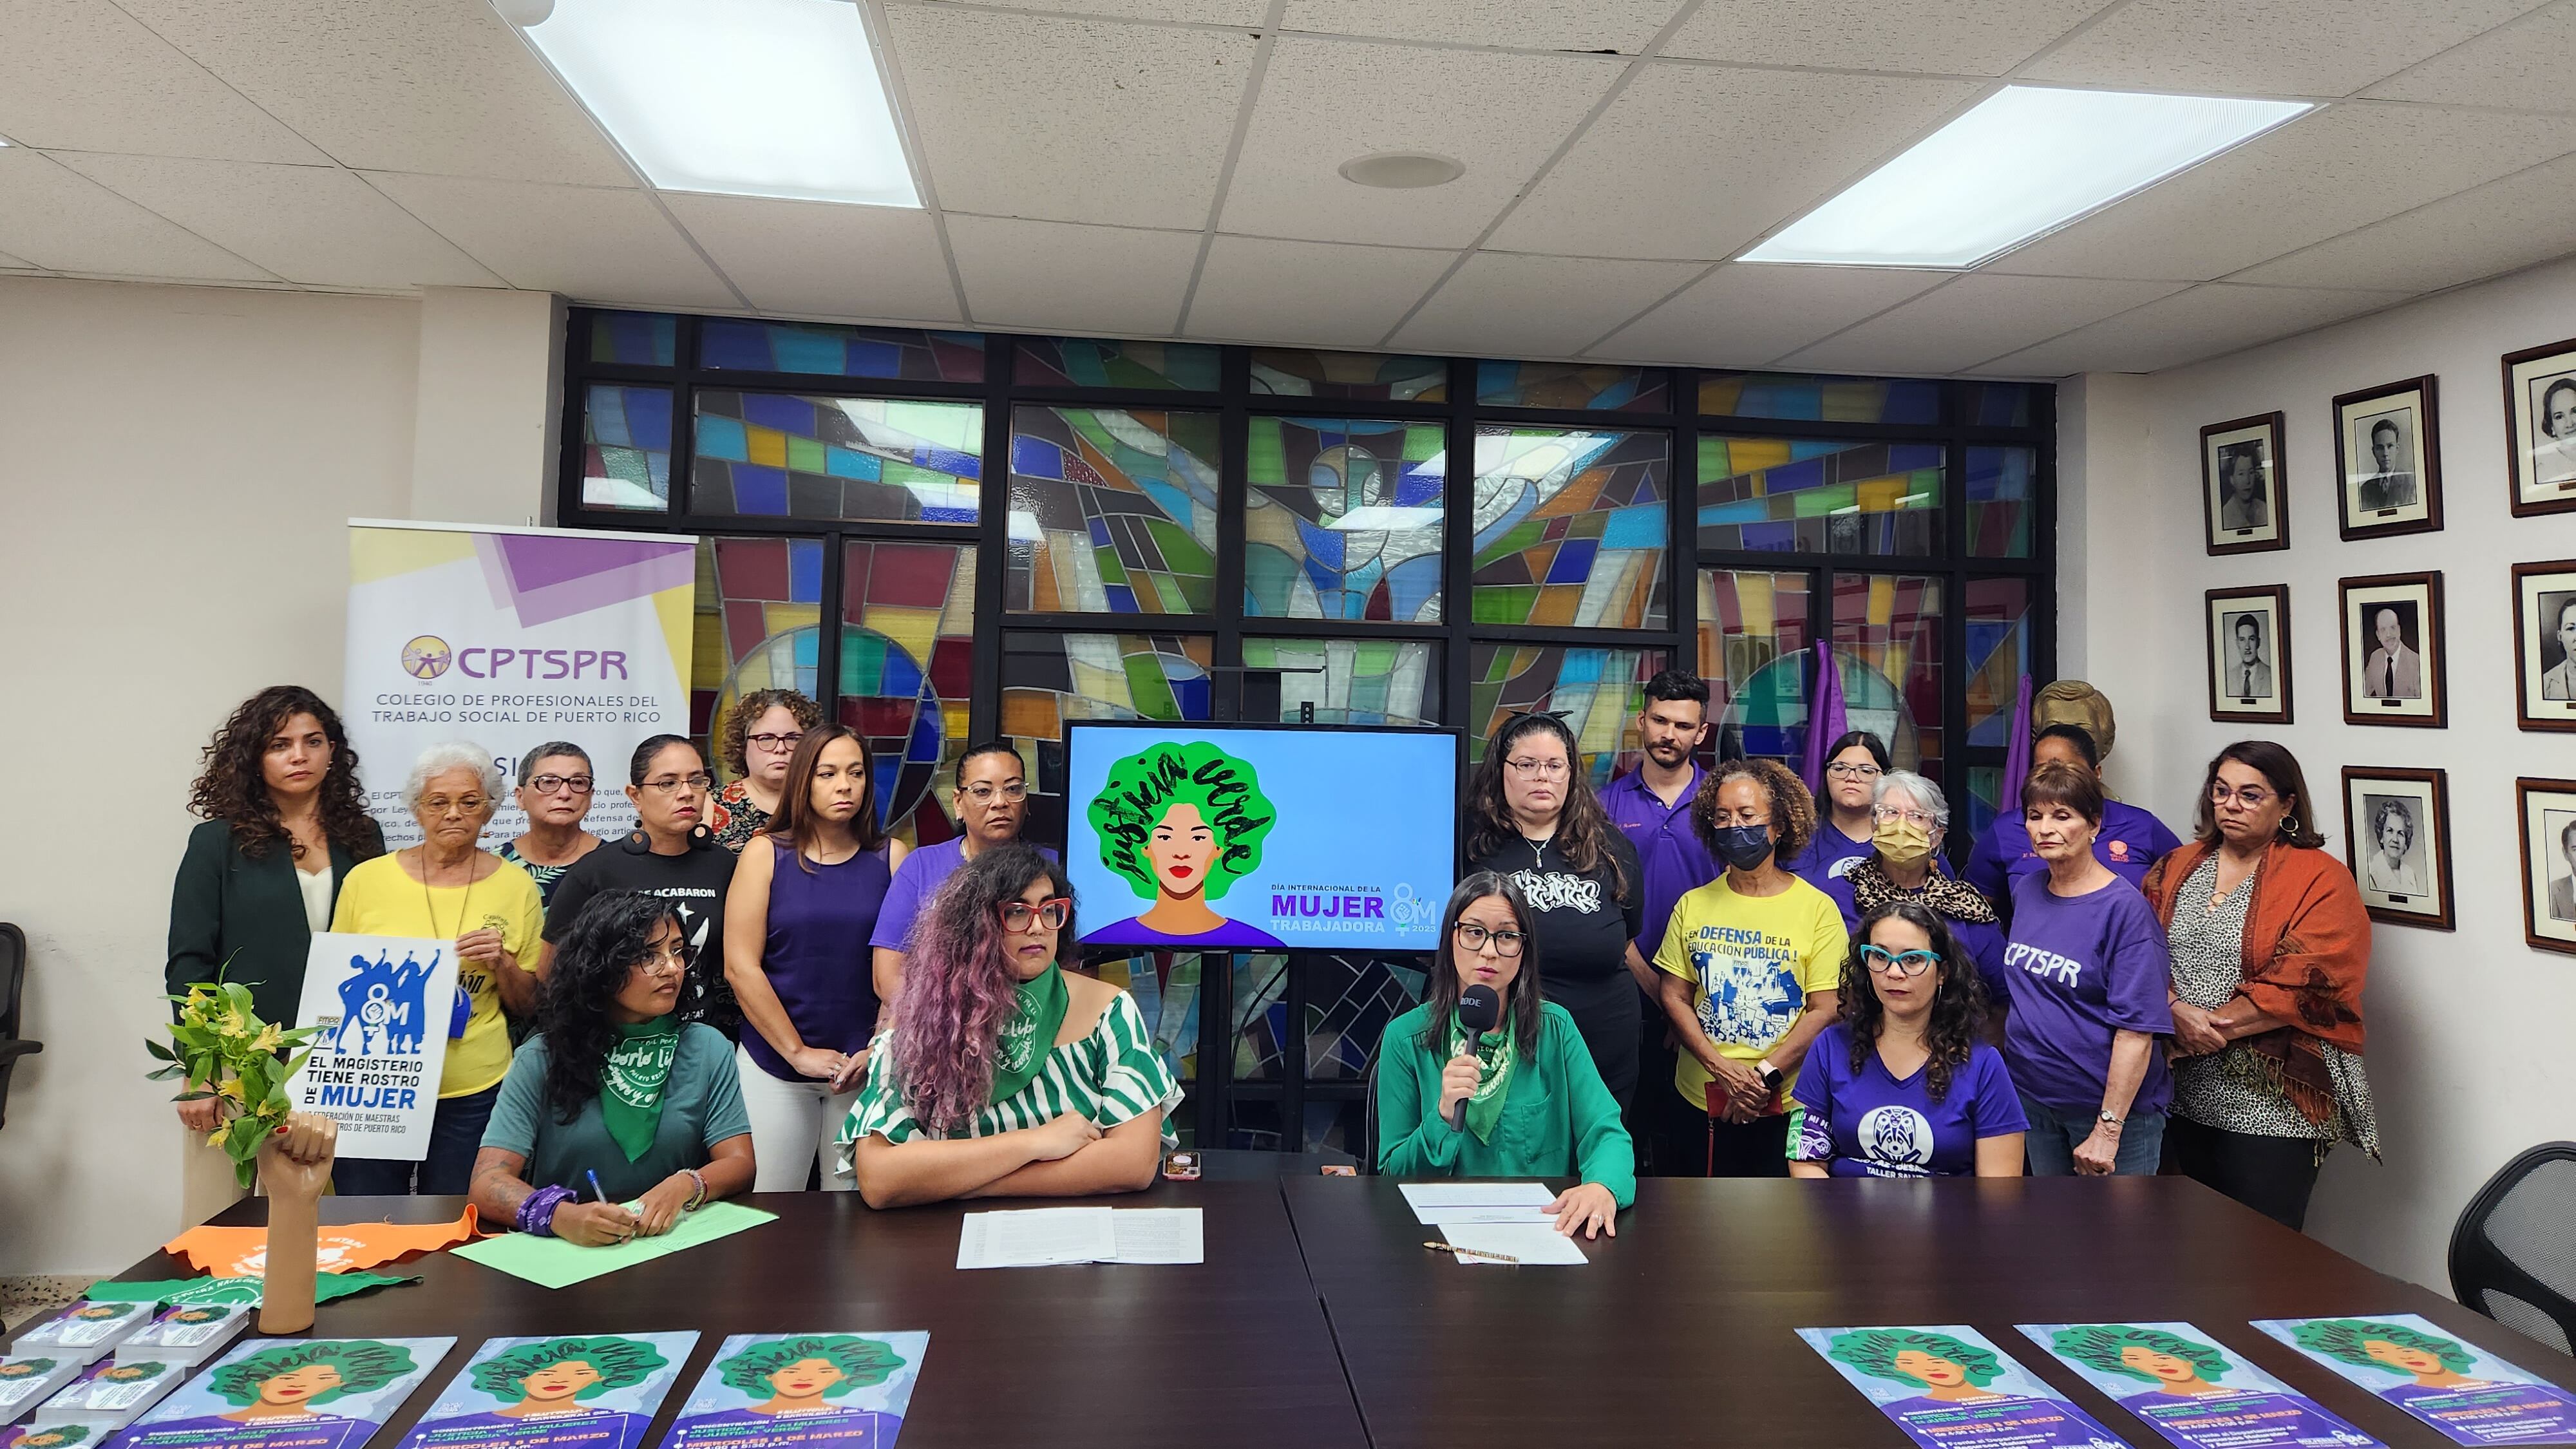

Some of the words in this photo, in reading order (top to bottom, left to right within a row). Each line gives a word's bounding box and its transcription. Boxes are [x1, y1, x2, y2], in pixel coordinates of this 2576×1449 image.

[458, 649, 628, 681] CPTSPR
[376, 694, 455, 706] COLEGIO
[463, 695, 484, 706] DE
[491, 696, 623, 706] PROFESIONALES
[630, 696, 658, 707] DEL
[372, 711, 452, 723] TRABAJO
[459, 711, 520, 723] SOCIAL
[527, 712, 548, 723] DE
[554, 712, 617, 723] PUERTO
[623, 712, 660, 723] RICO
[383, 791, 404, 800] CPT
[603, 790, 623, 800] que,
[654, 887, 716, 898] ACABARON
[1288, 884, 1355, 893] INTERNACIONAL
[1272, 894, 1385, 918] MUJER
[1270, 919, 1385, 933] TRABAJADORA
[1700, 925, 1762, 945] DEFENSA
[1765, 935, 1778, 945] DE
[1779, 936, 1791, 947] LA
[1687, 941, 1742, 957] EDUCACIÓN
[1744, 946, 1790, 962] PÚBLICA
[309, 1056, 327, 1068] EL
[332, 1057, 423, 1072] MAGISTERIO
[307, 1070, 355, 1084] TIENE
[360, 1073, 420, 1087] ROSTRO
[304, 1086, 317, 1104] DE
[320, 1084, 417, 1110] MUJER
[355, 1113, 363, 1122] DE
[365, 1113, 400, 1123] MAESTRAS
[354, 1123, 363, 1132] DE
[363, 1123, 389, 1133] PUERTO
[390, 1124, 406, 1134] RICO
[1866, 1166, 1896, 1179] TALLER
[2023, 1416, 2065, 1425] MARZO
[429, 1430, 488, 1438] JUSTICIA
[538, 1420, 598, 1429] MUJERES
[431, 1423, 515, 1434] CONCENTRACIÓN
[442, 1434, 500, 1442] JUSTICIA
[506, 1428, 548, 1437] VERDE
[554, 1432, 611, 1443] MARZO
[810, 1430, 864, 1440] MARZO
[1985, 1434, 2045, 1443] Departamento
[268, 1439, 329, 1448] MARZO
[2001, 1438, 2047, 1447] Naturales
